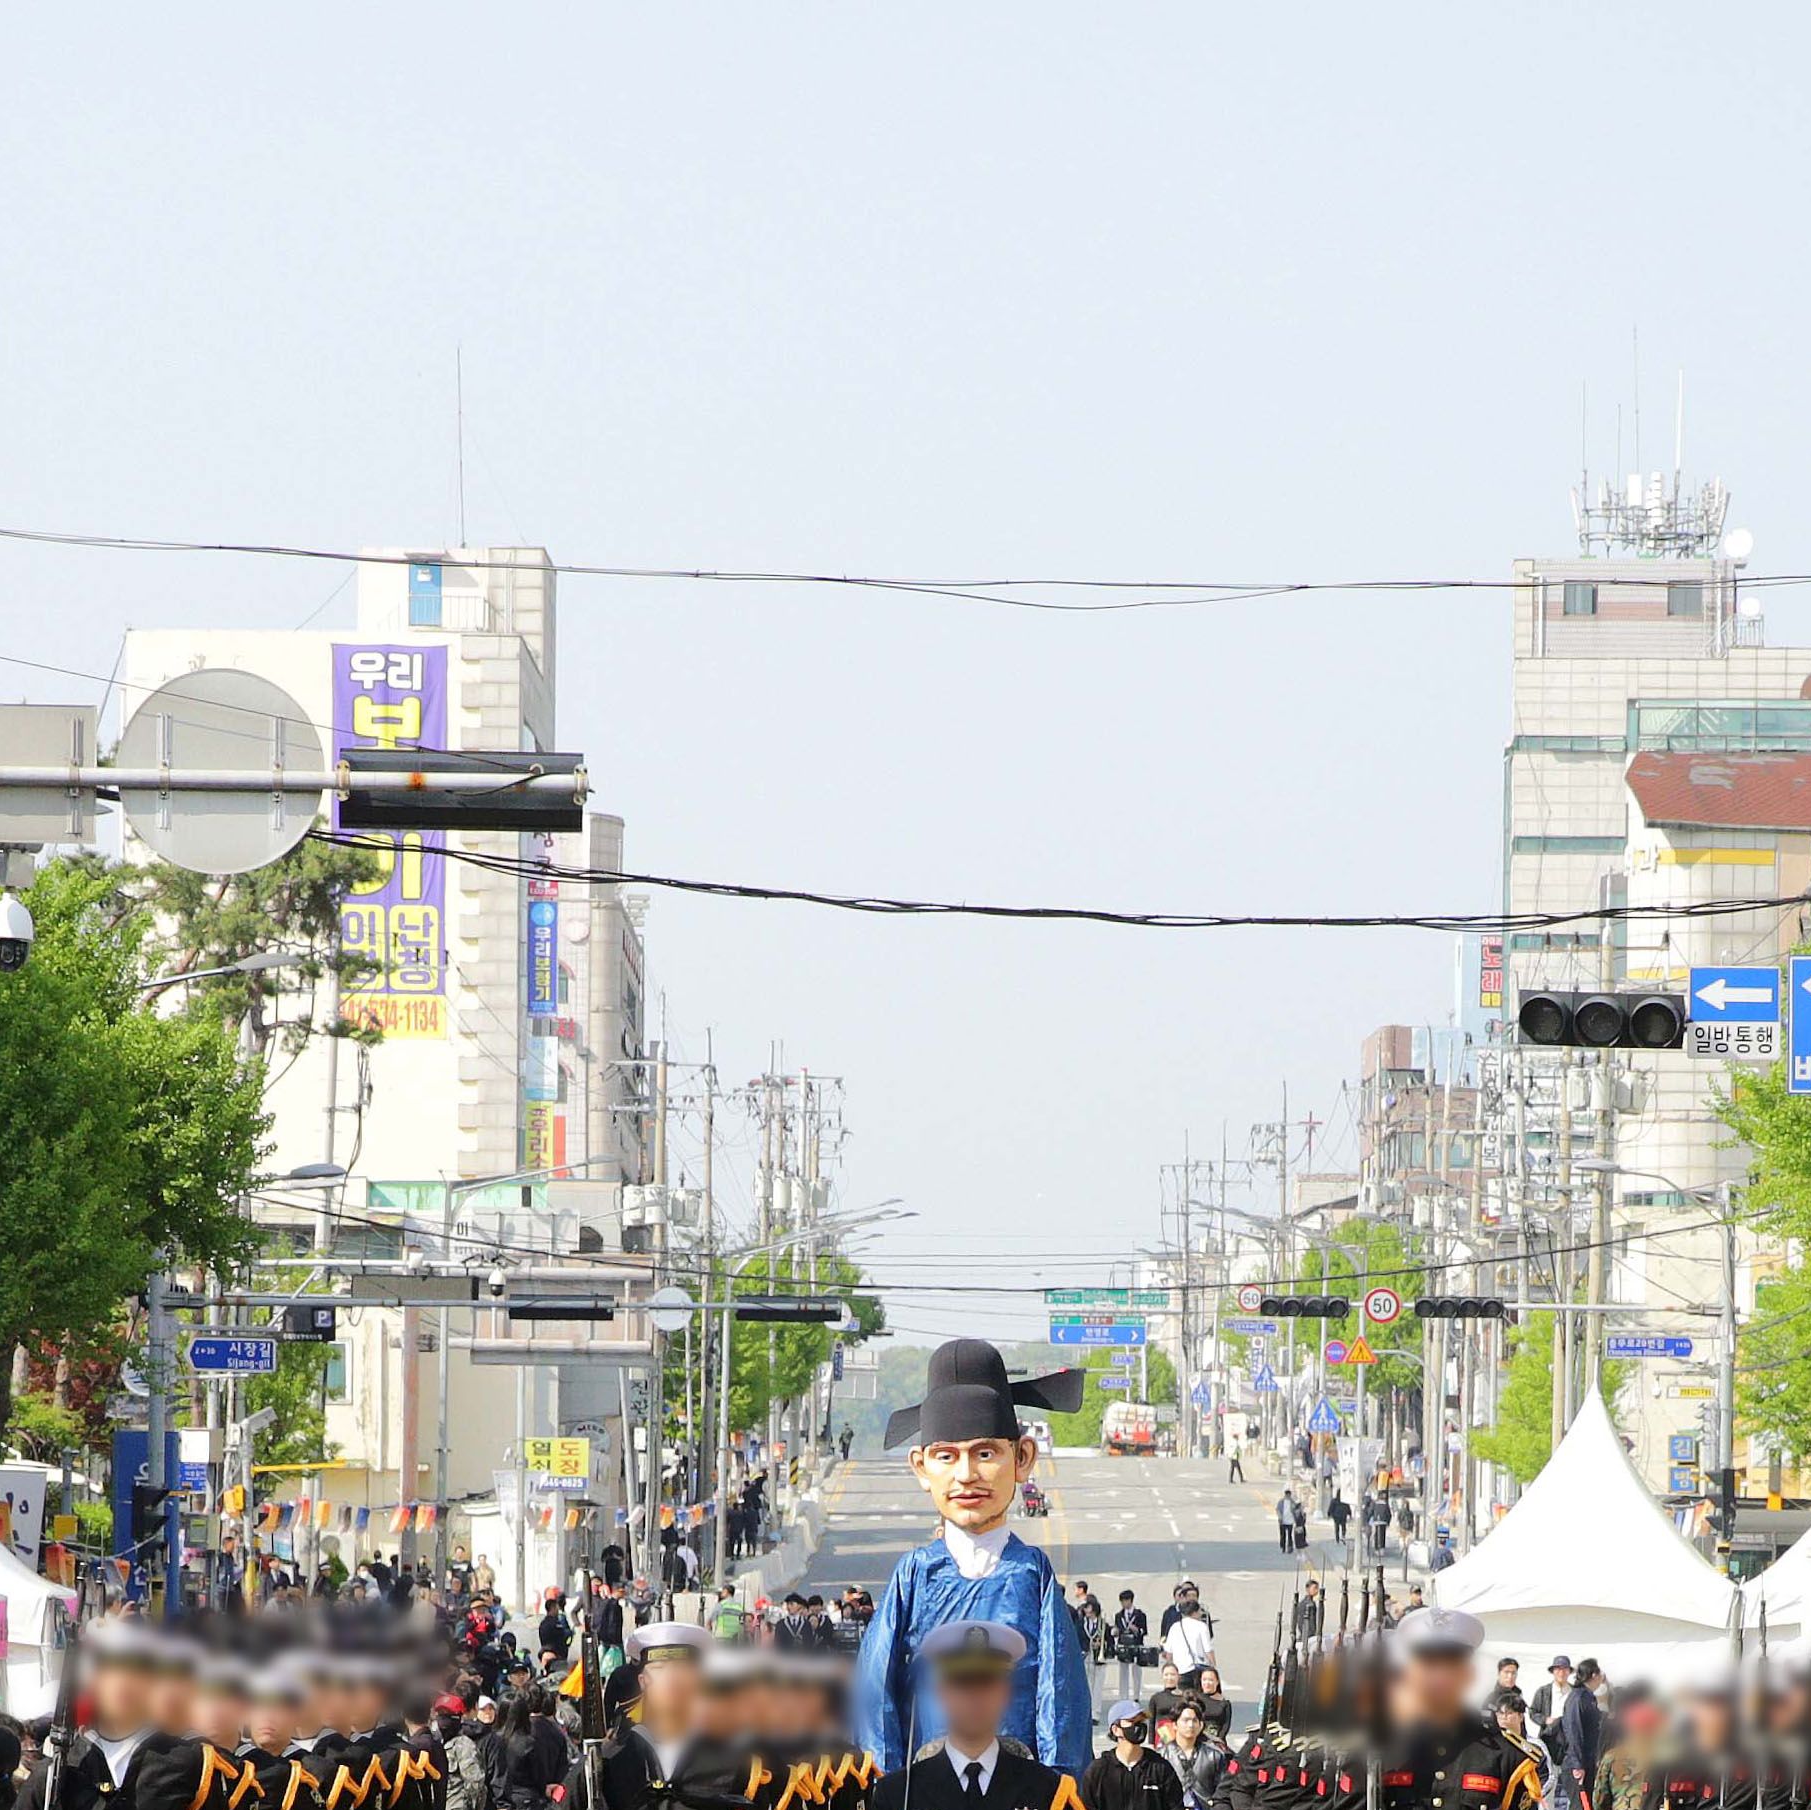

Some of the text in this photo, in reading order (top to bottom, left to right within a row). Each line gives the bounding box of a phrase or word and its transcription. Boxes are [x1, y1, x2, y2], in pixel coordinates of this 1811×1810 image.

[350, 651, 423, 691] 우리
[1695, 1025, 1774, 1054] 일방통행
[1243, 1292, 1259, 1305] 50
[1372, 1297, 1392, 1314] 50
[229, 1342, 271, 1358] 시장길
[227, 1357, 271, 1371] Sijang-gil
